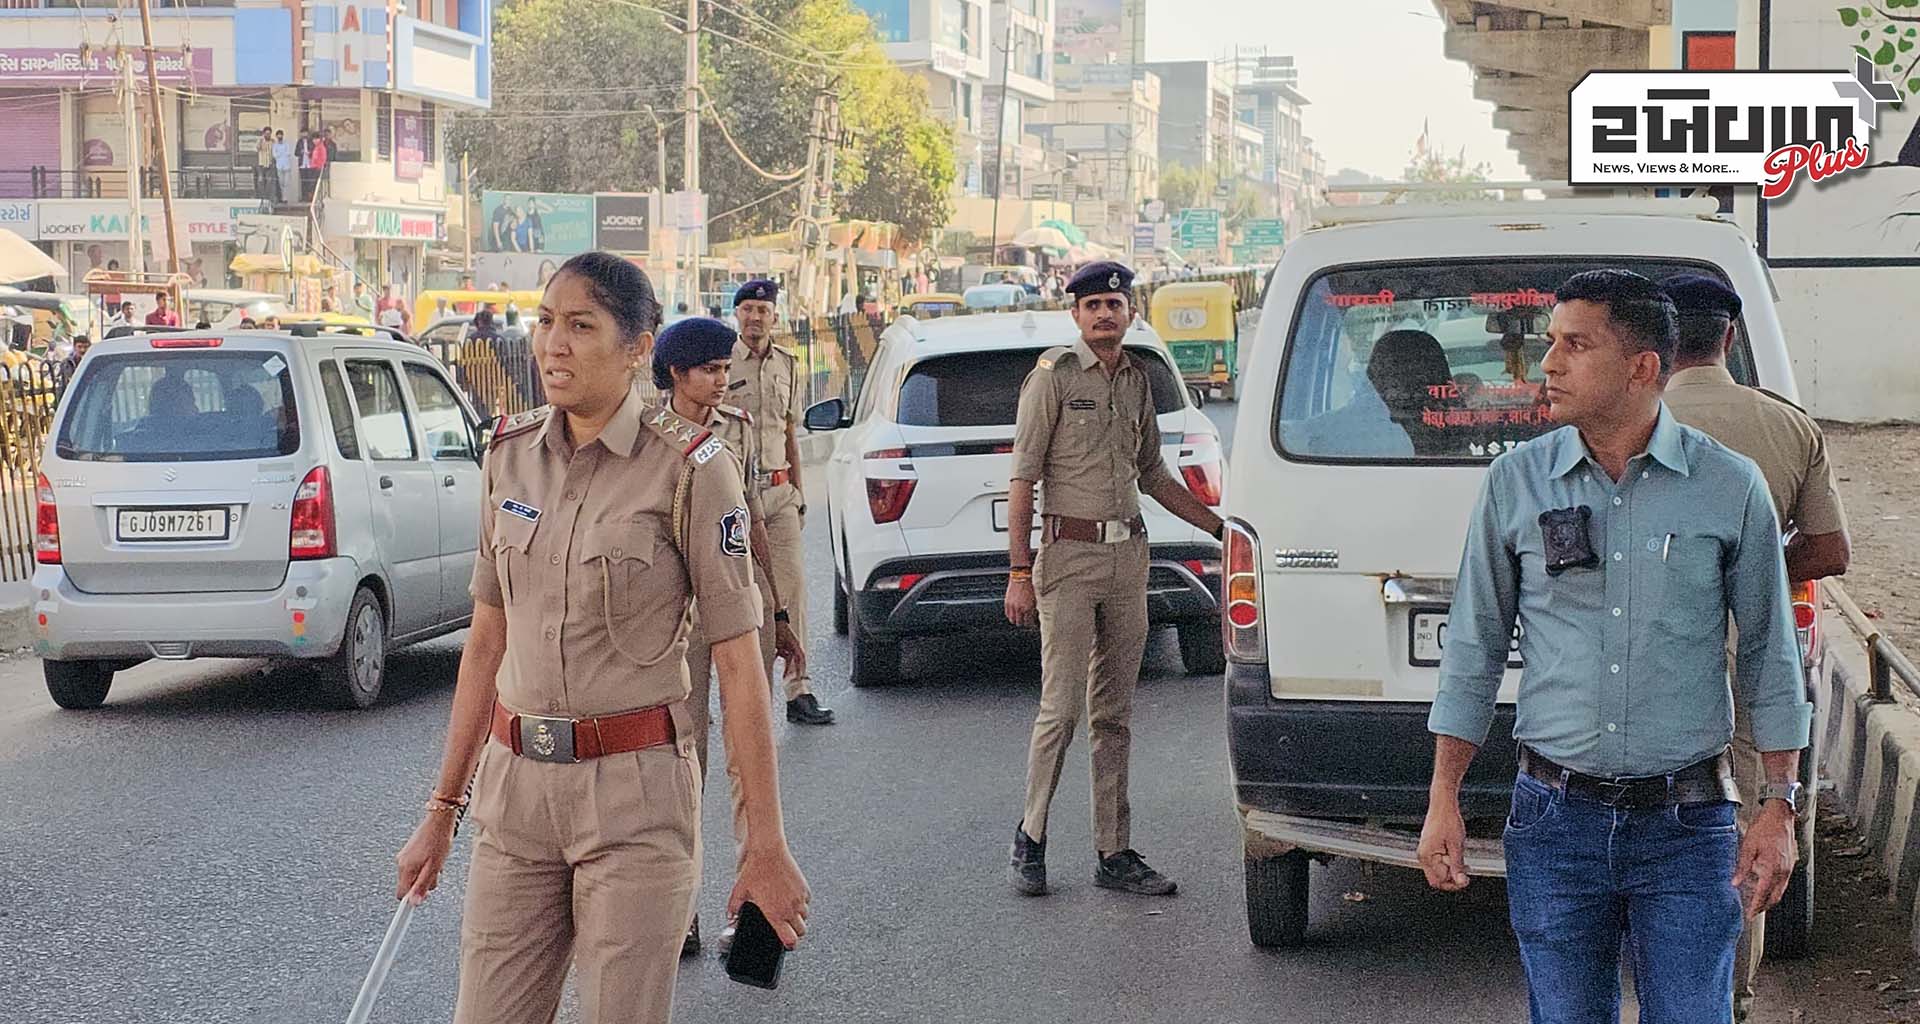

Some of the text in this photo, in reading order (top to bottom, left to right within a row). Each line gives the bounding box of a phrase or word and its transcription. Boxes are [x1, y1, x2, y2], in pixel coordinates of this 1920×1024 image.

[601, 215, 644, 226] JOCKEY
[41, 224, 85, 235] JOCKEY
[188, 222, 228, 233] STYLE
[129, 514, 213, 533] GJ09M7261
[1275, 557, 1339, 568] SUZUKI
